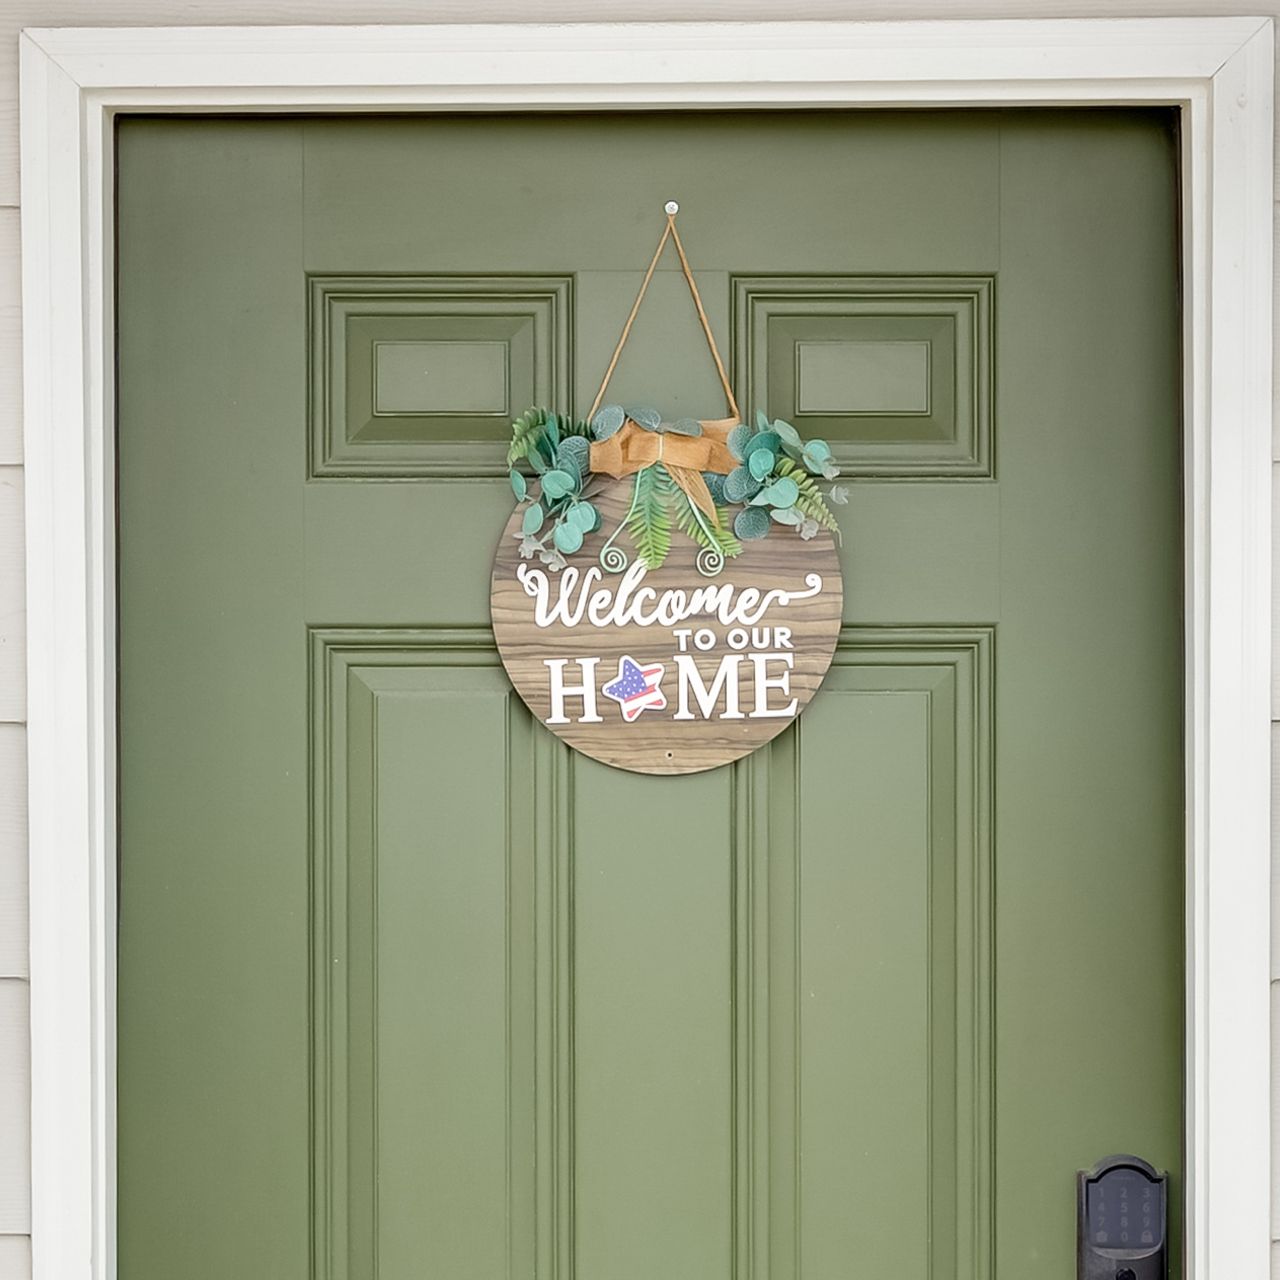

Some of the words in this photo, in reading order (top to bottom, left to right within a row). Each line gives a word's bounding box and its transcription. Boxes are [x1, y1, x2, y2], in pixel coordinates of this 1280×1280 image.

[517, 557, 822, 627] Welcome
[673, 629, 716, 651] TO
[727, 627, 794, 650] OUR
[543, 653, 798, 724] HME
